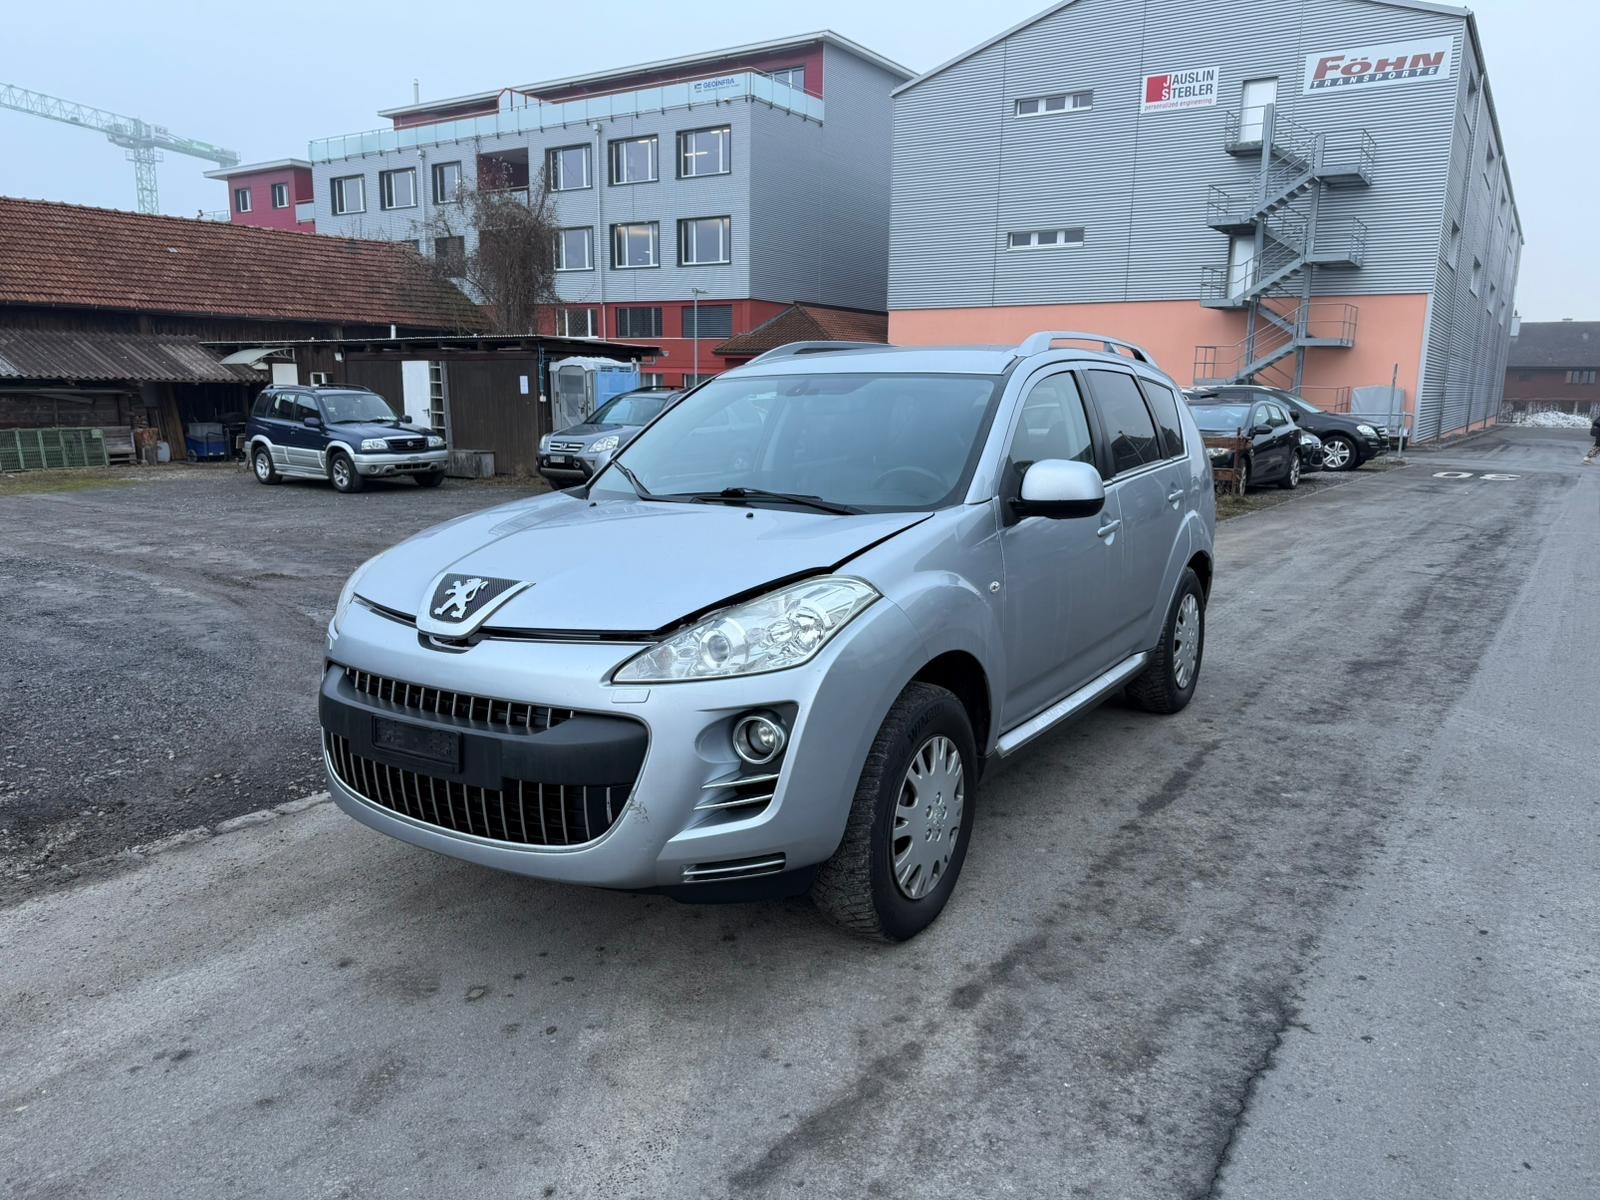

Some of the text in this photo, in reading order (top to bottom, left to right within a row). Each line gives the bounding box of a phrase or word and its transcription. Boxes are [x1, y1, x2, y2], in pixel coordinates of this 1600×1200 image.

[1313, 51, 1445, 80] FÖHN
[1162, 70, 1214, 87] JAUSLIN
[1312, 67, 1436, 88] TRANSPORTE
[1161, 83, 1214, 101] STEBLER
